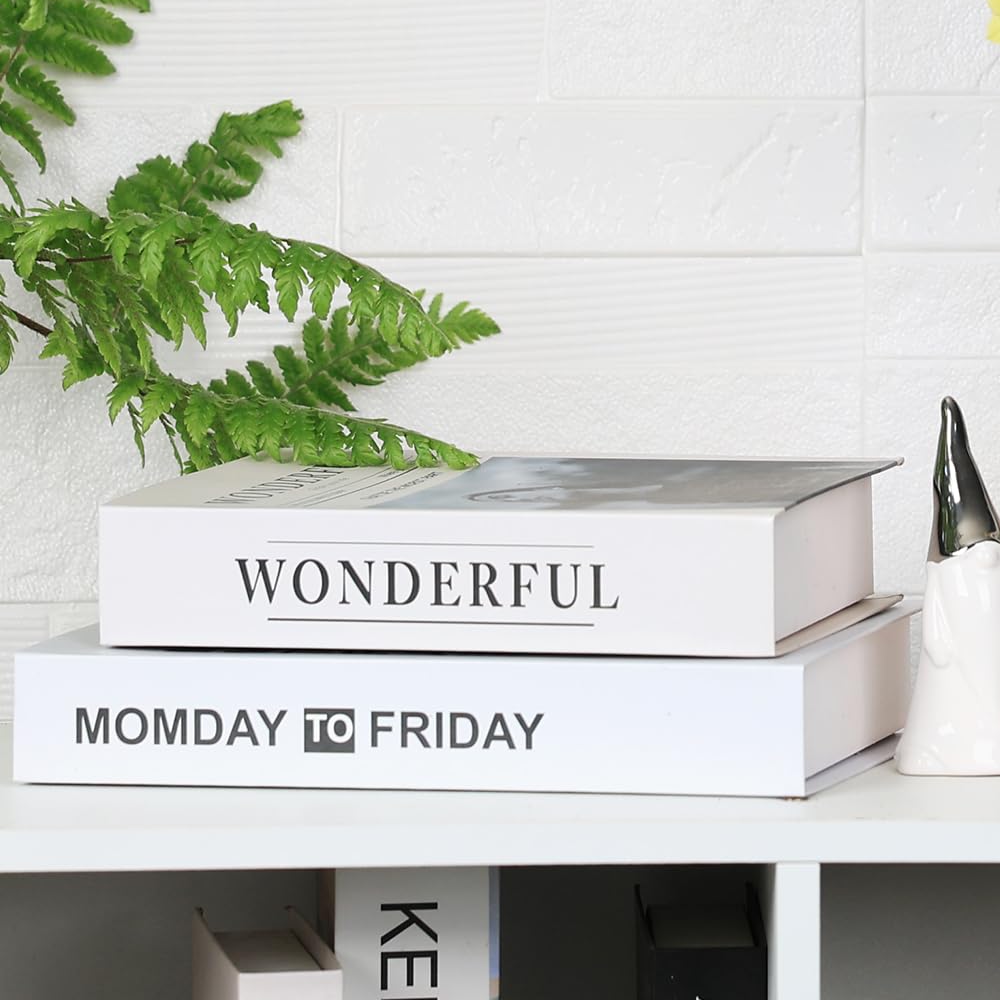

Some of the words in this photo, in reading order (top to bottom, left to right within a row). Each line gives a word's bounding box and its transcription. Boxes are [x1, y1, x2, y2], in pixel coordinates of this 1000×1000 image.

[204, 464, 358, 504] WONDERF
[235, 558, 619, 609] WONDERFUL
[75, 707, 287, 747] MOMDAY
[305, 711, 354, 745] TO
[370, 711, 545, 750] FRIDAY
[380, 901, 439, 1000] KE
